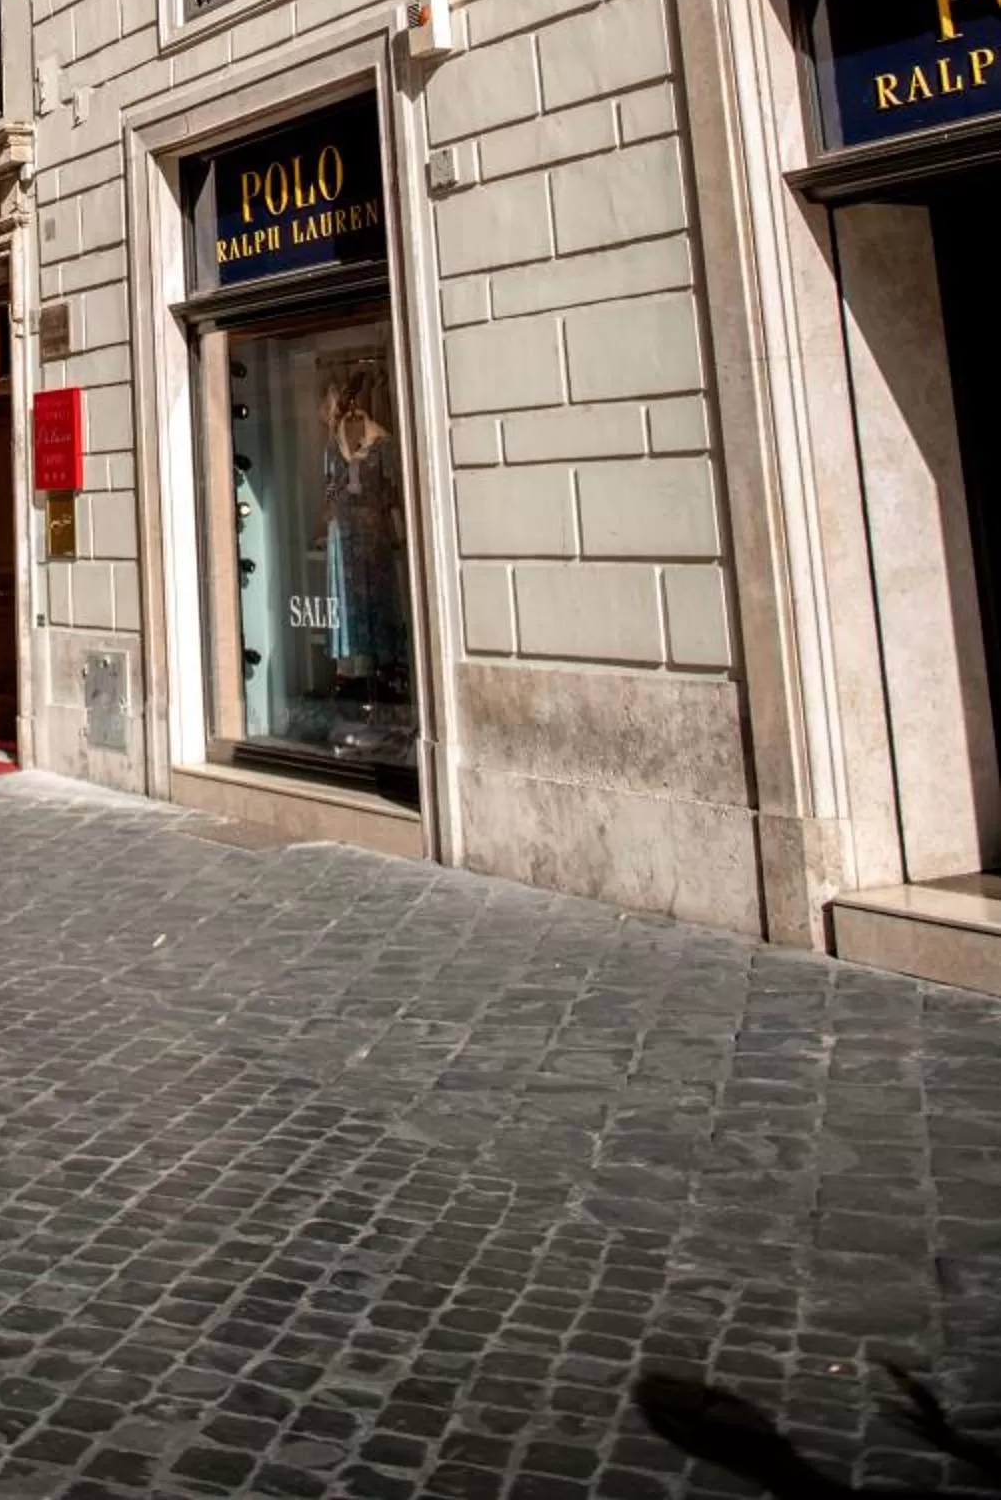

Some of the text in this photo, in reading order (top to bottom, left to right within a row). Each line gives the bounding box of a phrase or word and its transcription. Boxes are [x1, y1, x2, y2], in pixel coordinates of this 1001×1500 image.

[240, 145, 344, 224] POLO
[216, 225, 281, 264] RALPH
[290, 595, 340, 629] SALE
